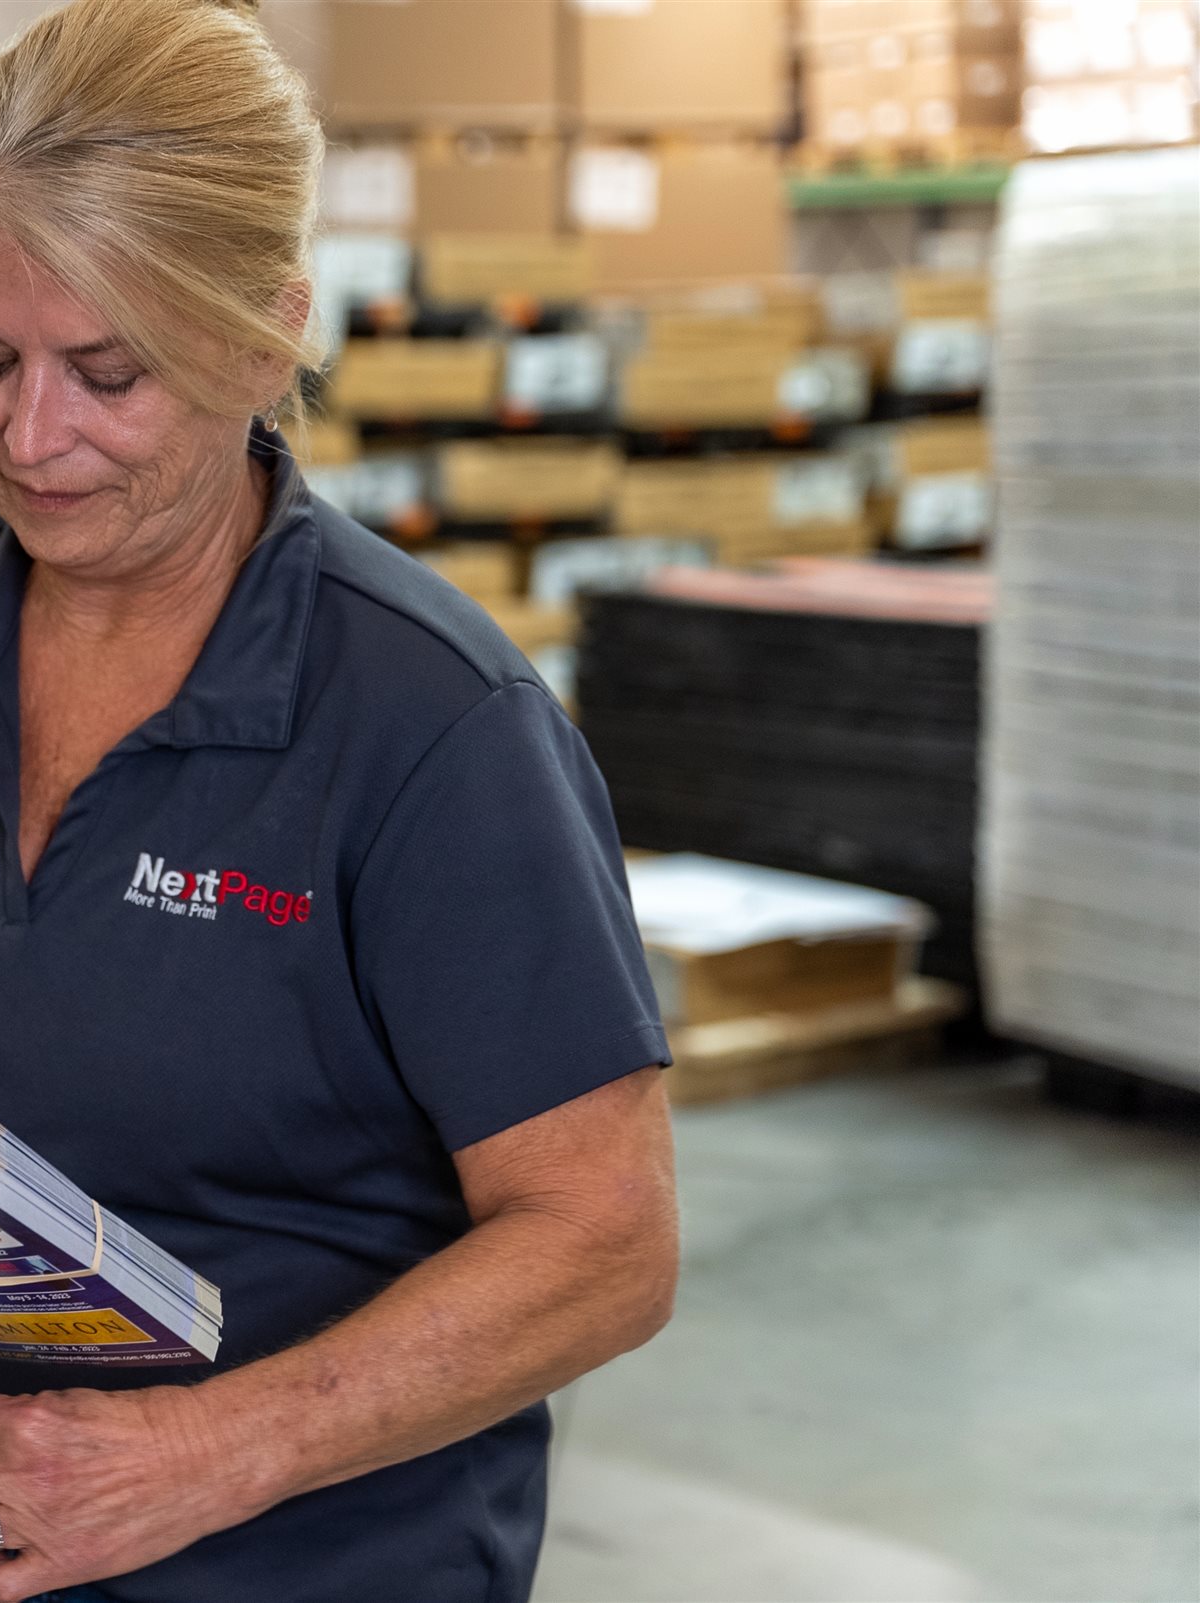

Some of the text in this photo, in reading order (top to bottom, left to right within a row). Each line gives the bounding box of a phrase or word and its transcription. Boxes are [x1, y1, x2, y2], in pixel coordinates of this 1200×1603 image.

[124, 887, 217, 921] More Than Print
